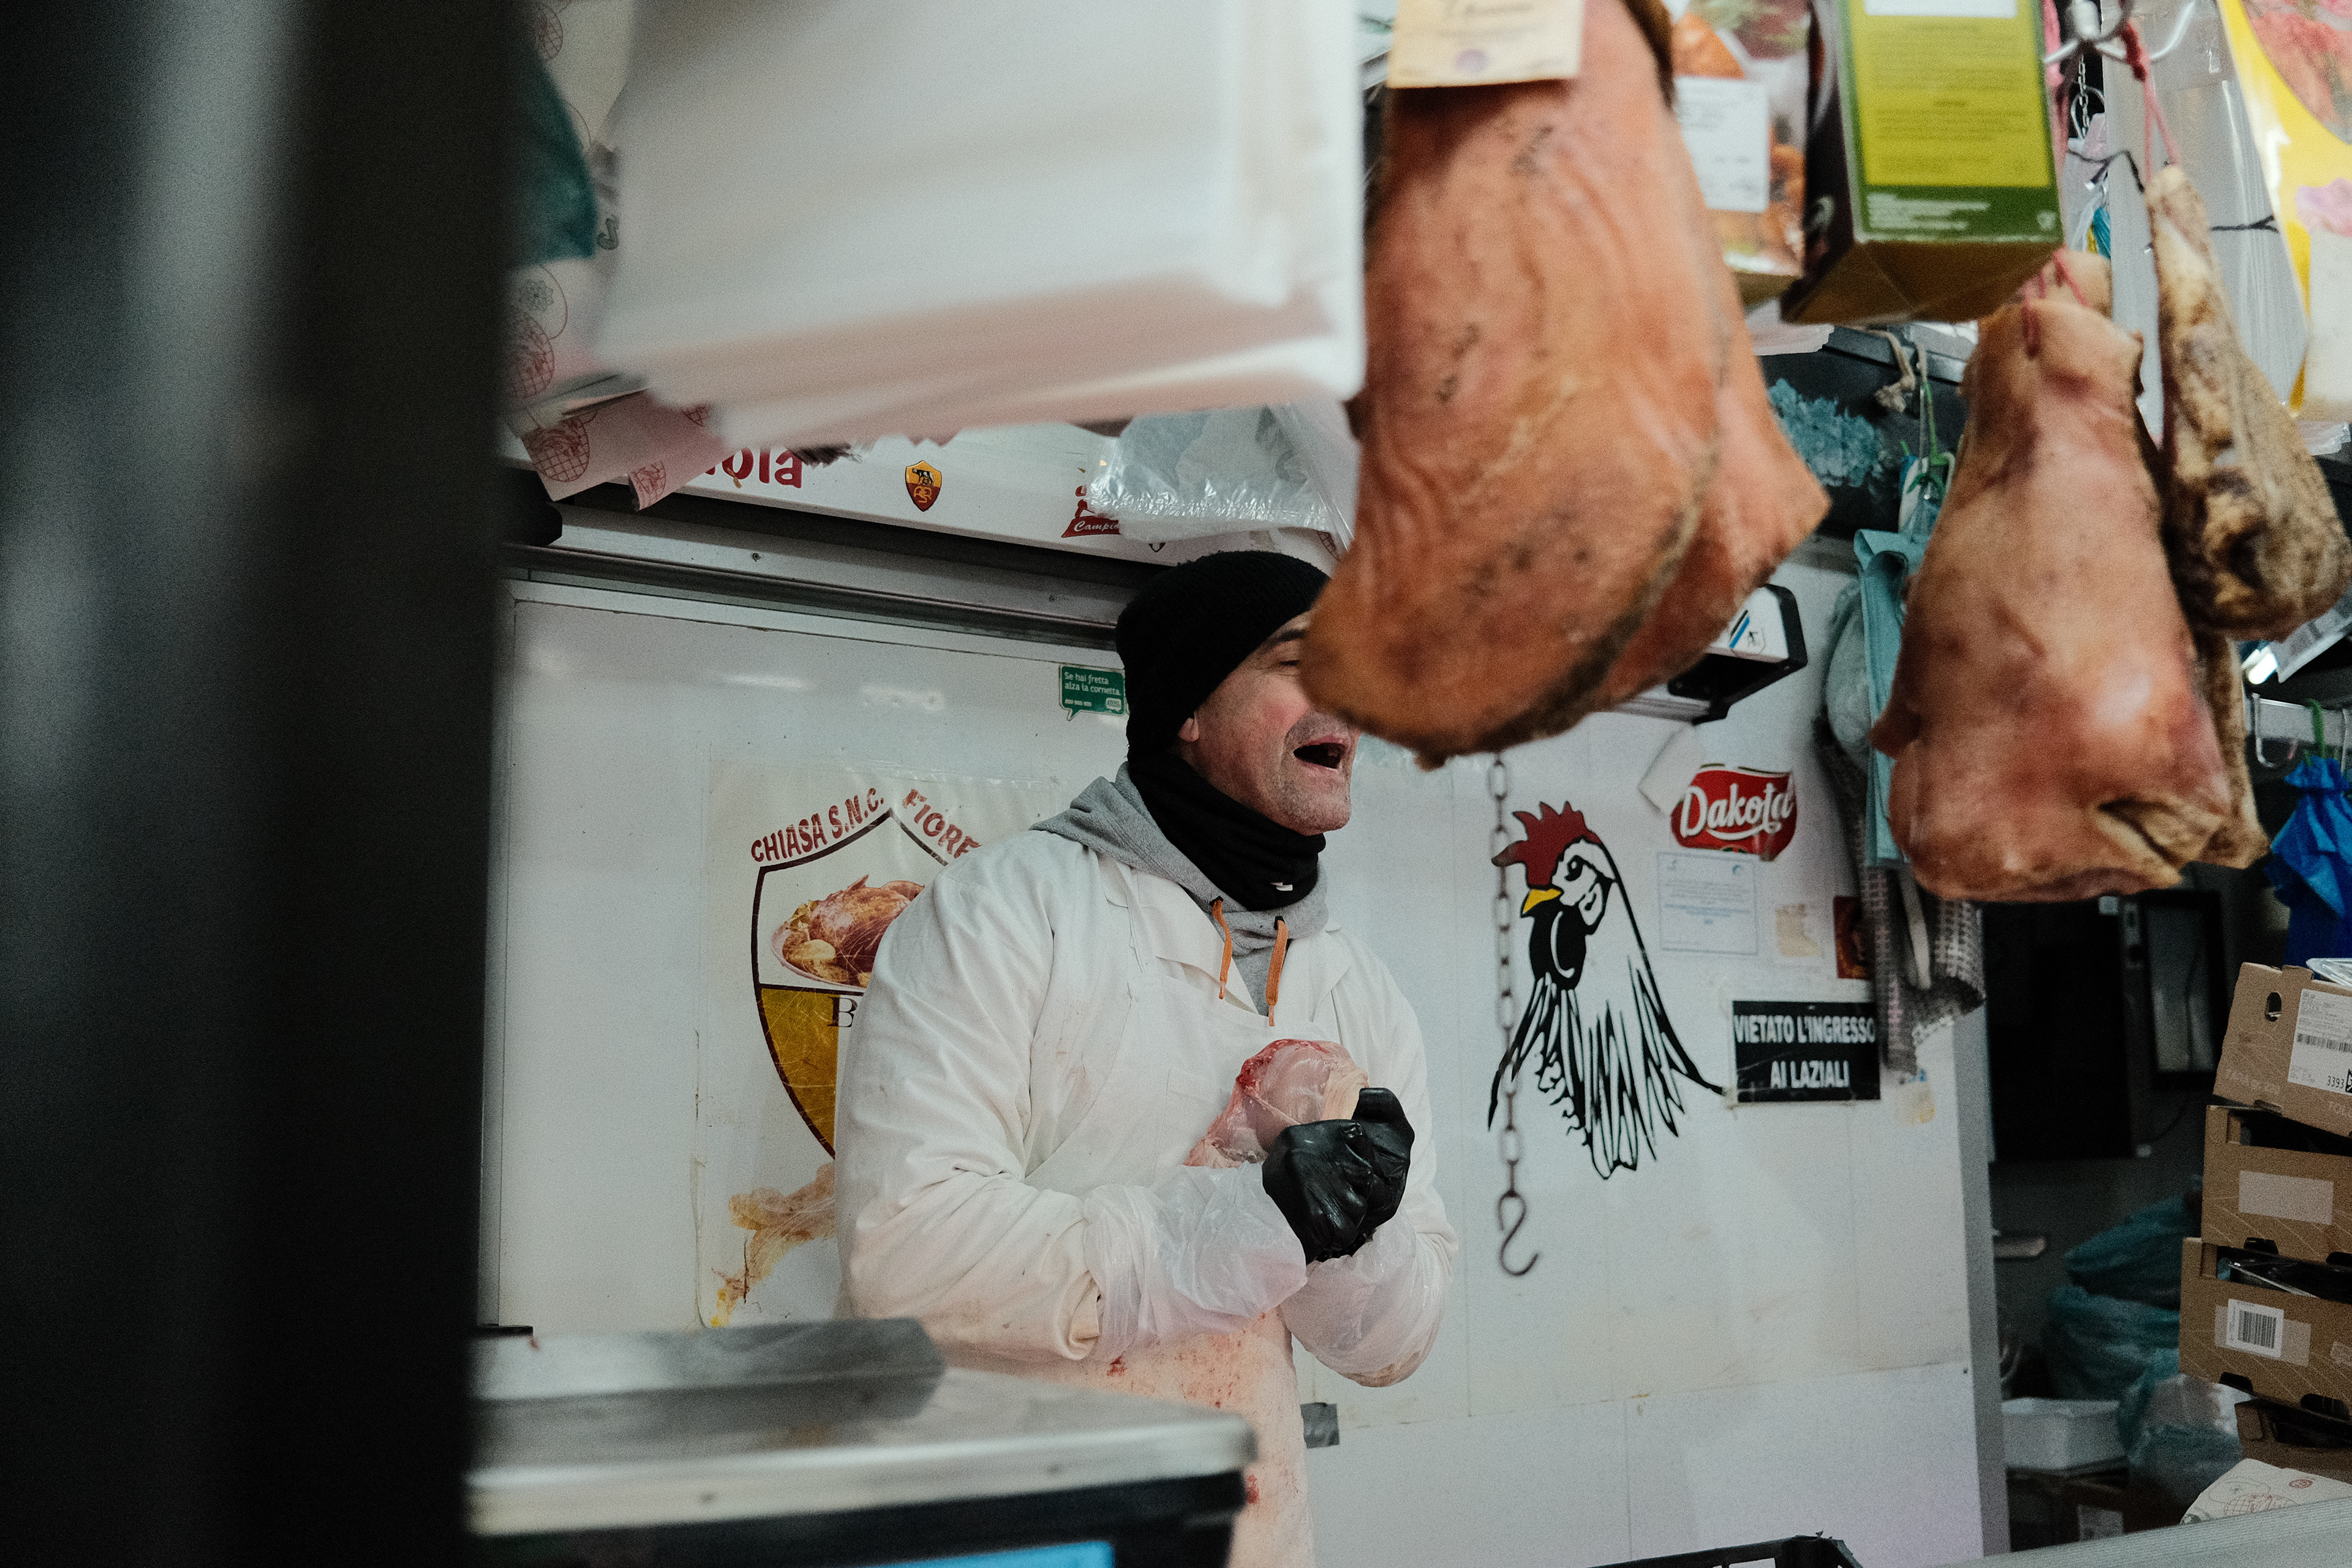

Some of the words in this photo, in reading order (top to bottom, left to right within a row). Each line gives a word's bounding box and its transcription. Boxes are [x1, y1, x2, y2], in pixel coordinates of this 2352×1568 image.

[1065, 681, 1080, 690] alza
[1082, 683, 1088, 692] la
[1075, 673, 1086, 682] hai
[1088, 674, 1109, 684] fretta
[751, 812, 828, 862] CHIASA
[828, 788, 884, 839] S.N.C.
[1679, 782, 1794, 840] Dakota
[1733, 1014, 1795, 1043] VIETATO
[1796, 1015, 1875, 1044] L'INGRESSO
[1771, 1060, 1787, 1089] AI
[1790, 1060, 1850, 1088] LAZIALI
